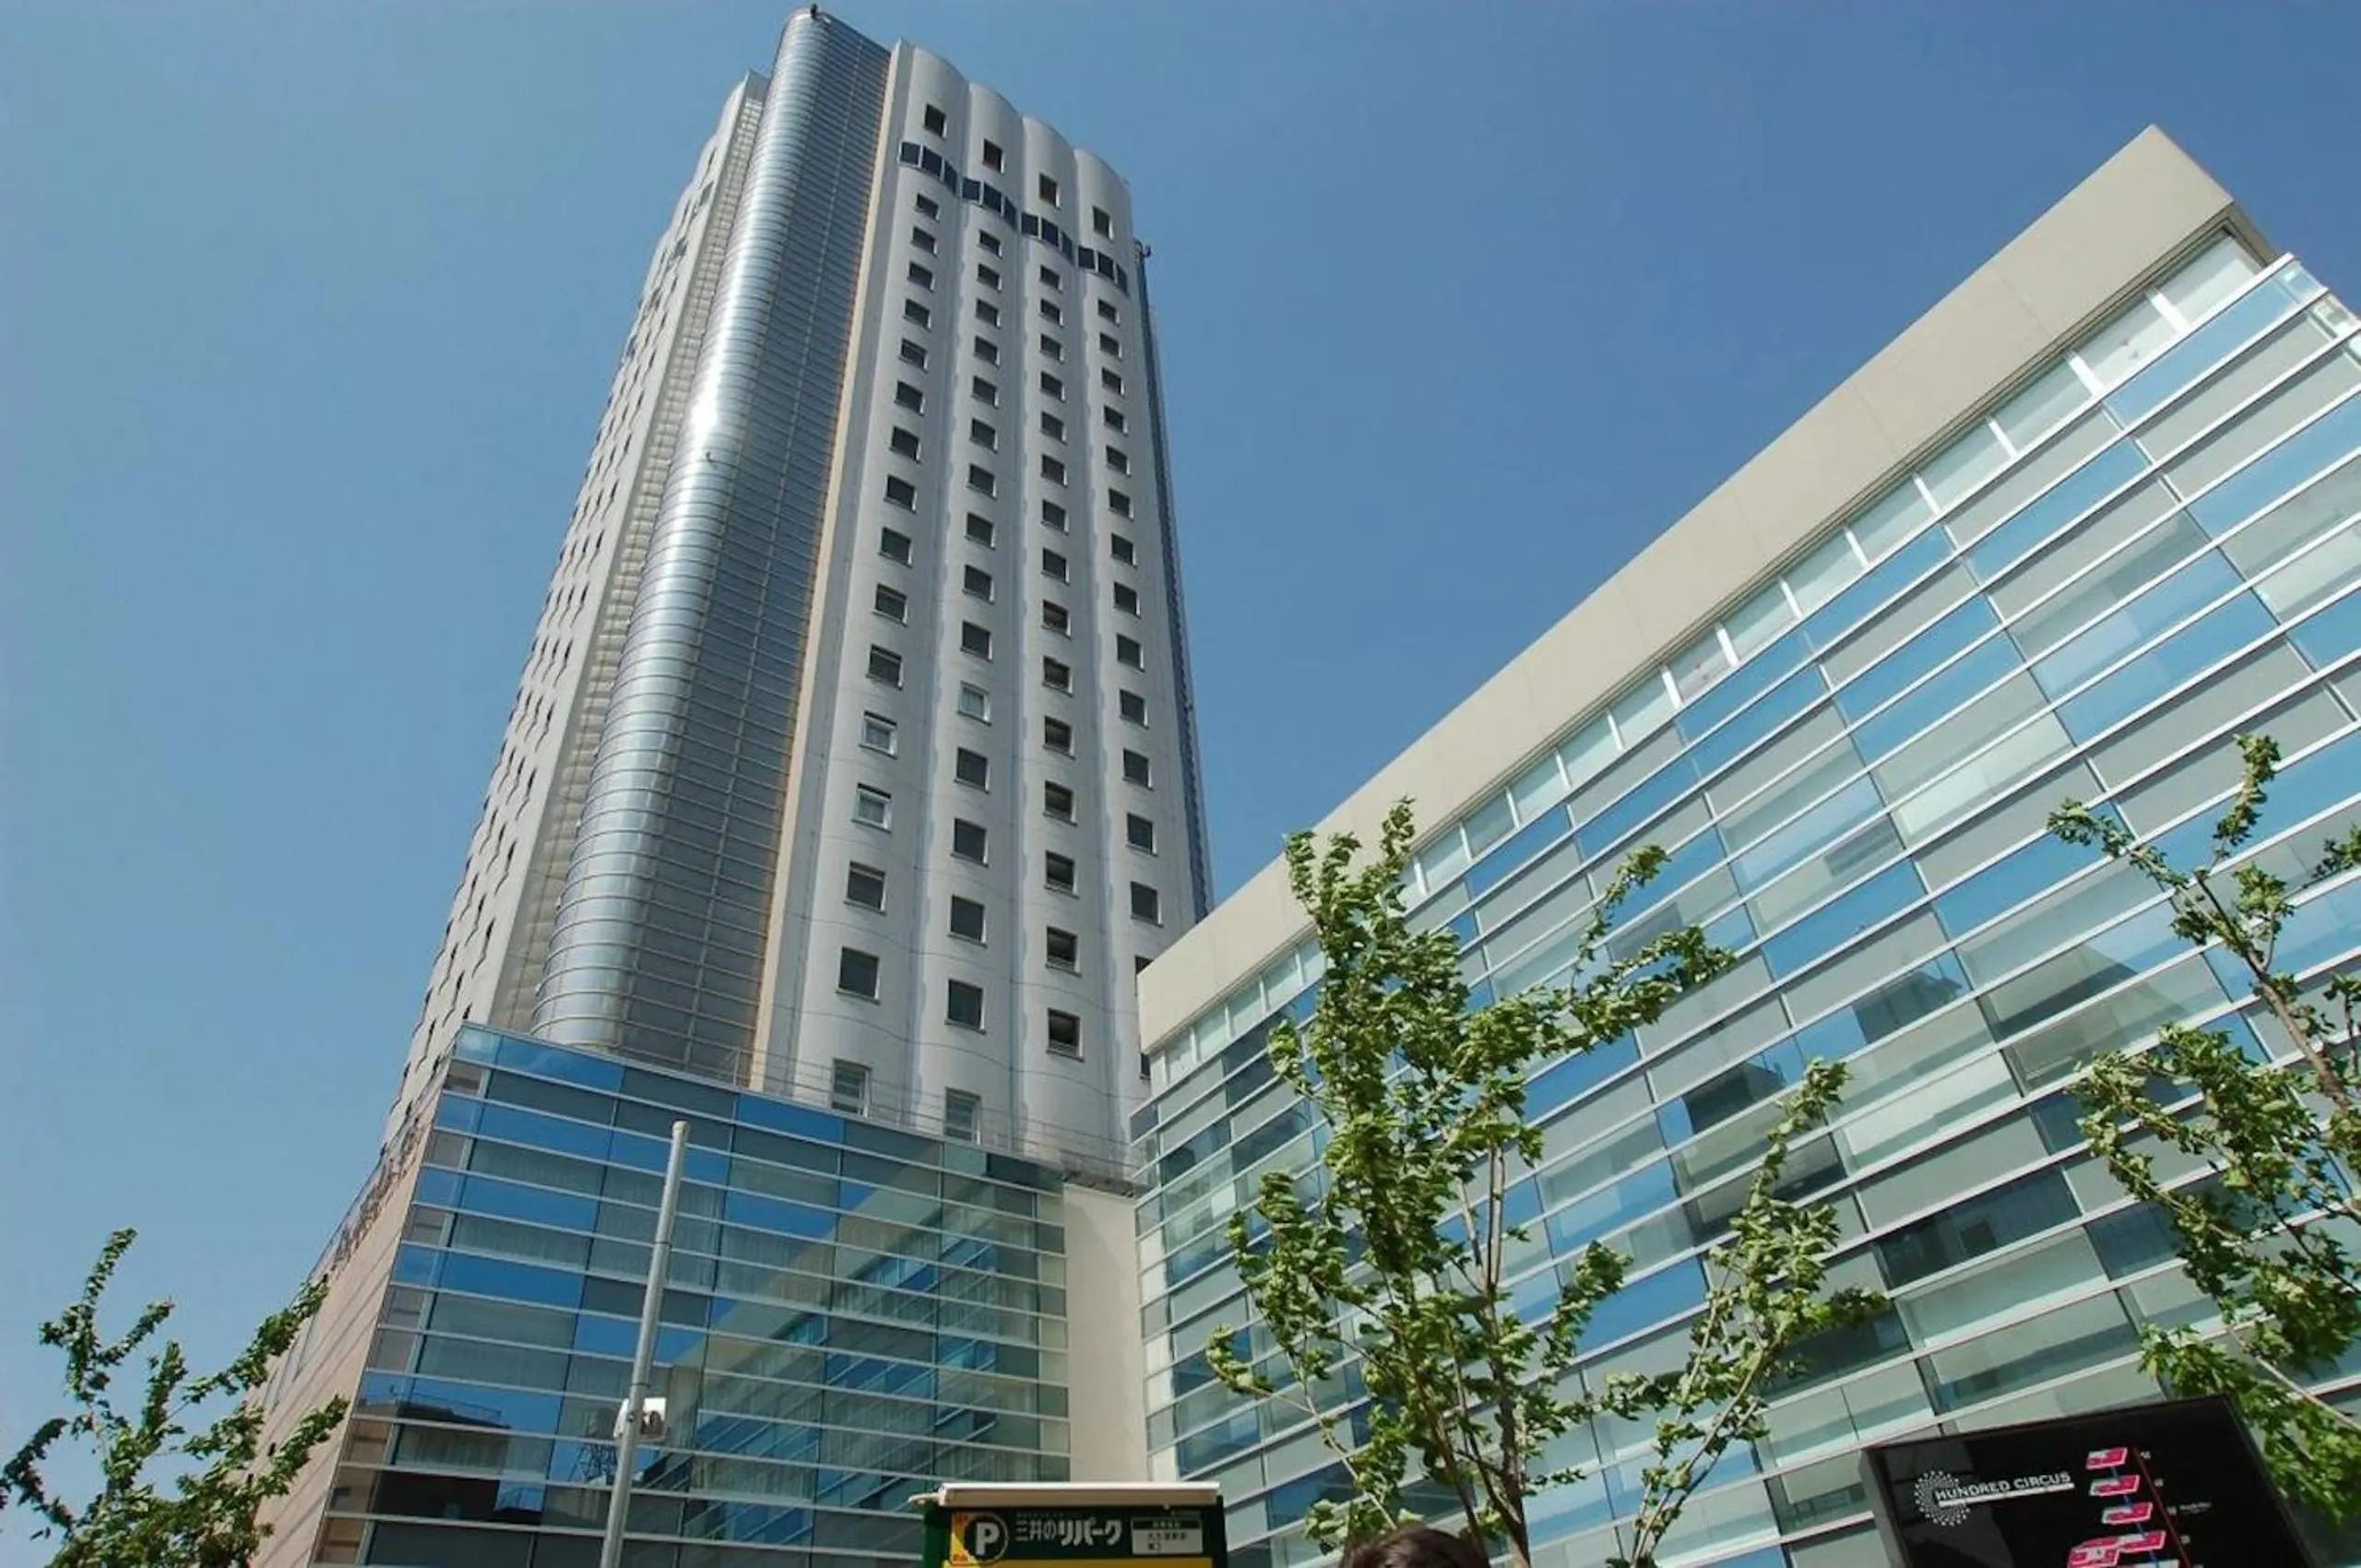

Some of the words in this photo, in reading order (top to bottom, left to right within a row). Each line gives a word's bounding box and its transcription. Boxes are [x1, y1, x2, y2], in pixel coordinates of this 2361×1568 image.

[1934, 1481, 2011, 1501] HUNDRED
[2013, 1471, 2071, 1489] CIRCUS
[976, 1522, 1000, 1555] P
[1015, 1518, 1122, 1546] 三井のリパーク
